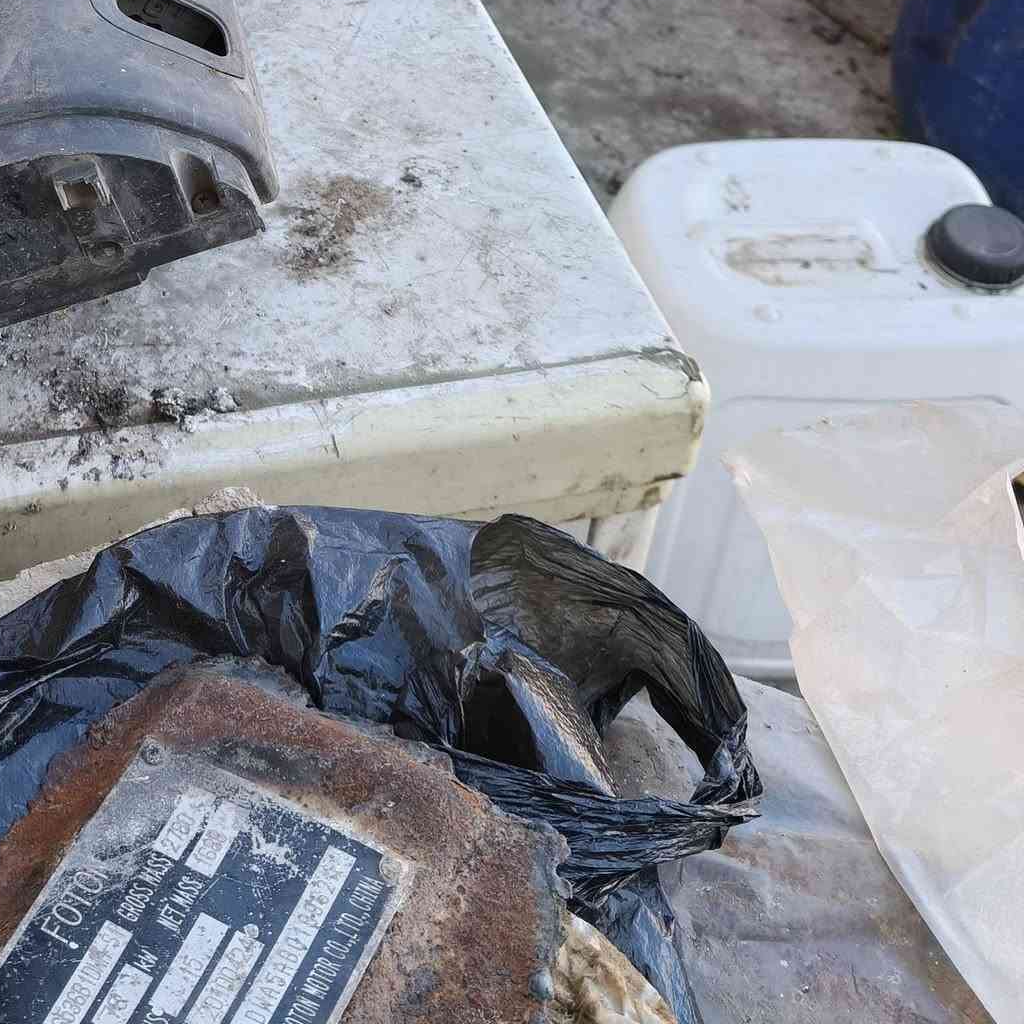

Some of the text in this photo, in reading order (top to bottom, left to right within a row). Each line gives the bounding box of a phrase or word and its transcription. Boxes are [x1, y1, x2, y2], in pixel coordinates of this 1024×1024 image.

[115, 850, 173, 924] GROSS MASS
[156, 873, 204, 933] NET MASS
[132, 946, 159, 973] kW
[300, 954, 343, 1002] MOTOR
